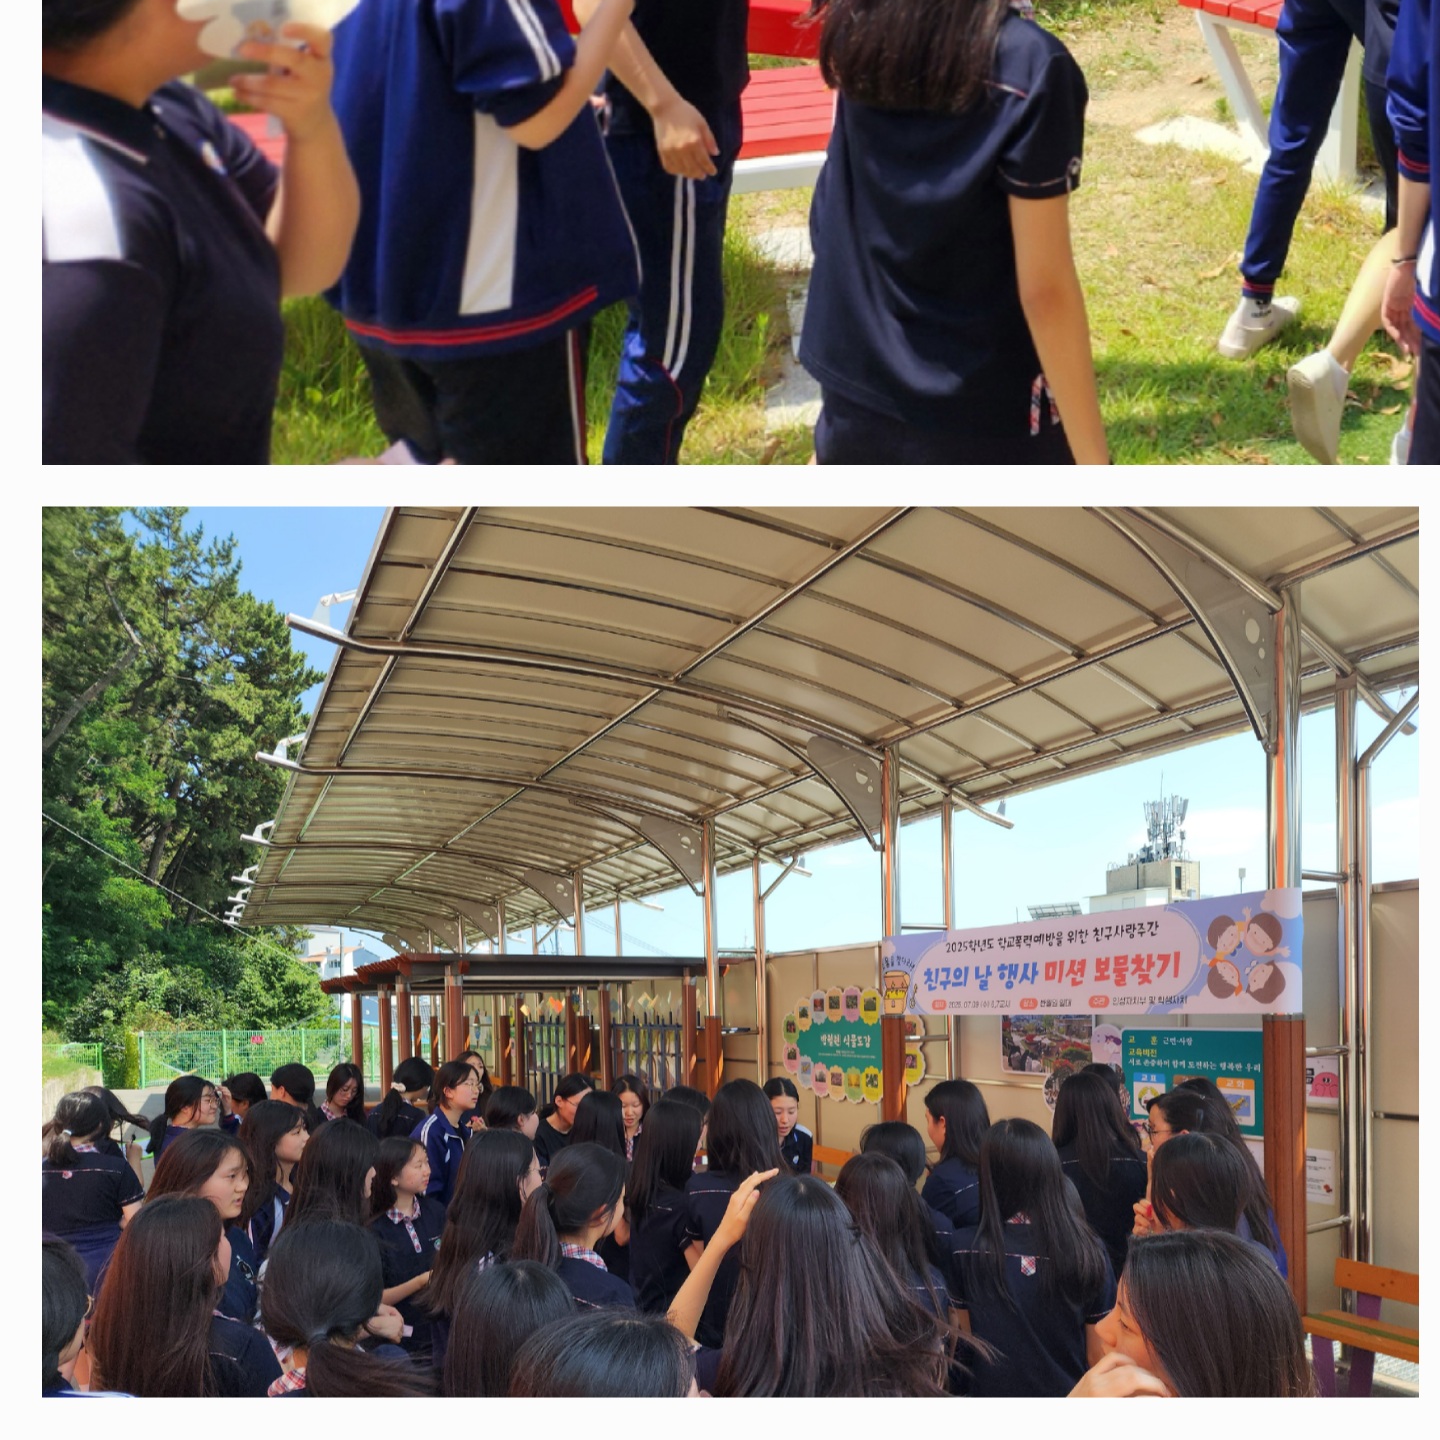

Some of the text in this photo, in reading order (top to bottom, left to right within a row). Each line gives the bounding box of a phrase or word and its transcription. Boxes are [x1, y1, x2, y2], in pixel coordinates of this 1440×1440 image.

[946, 921, 1159, 954] 2025학년도 학교폭력예방을 위한 친구사랑주간
[923, 951, 1181, 991] 친구의 날 행사 미션 보물찾기
[843, 1034, 871, 1048] 식물도감
